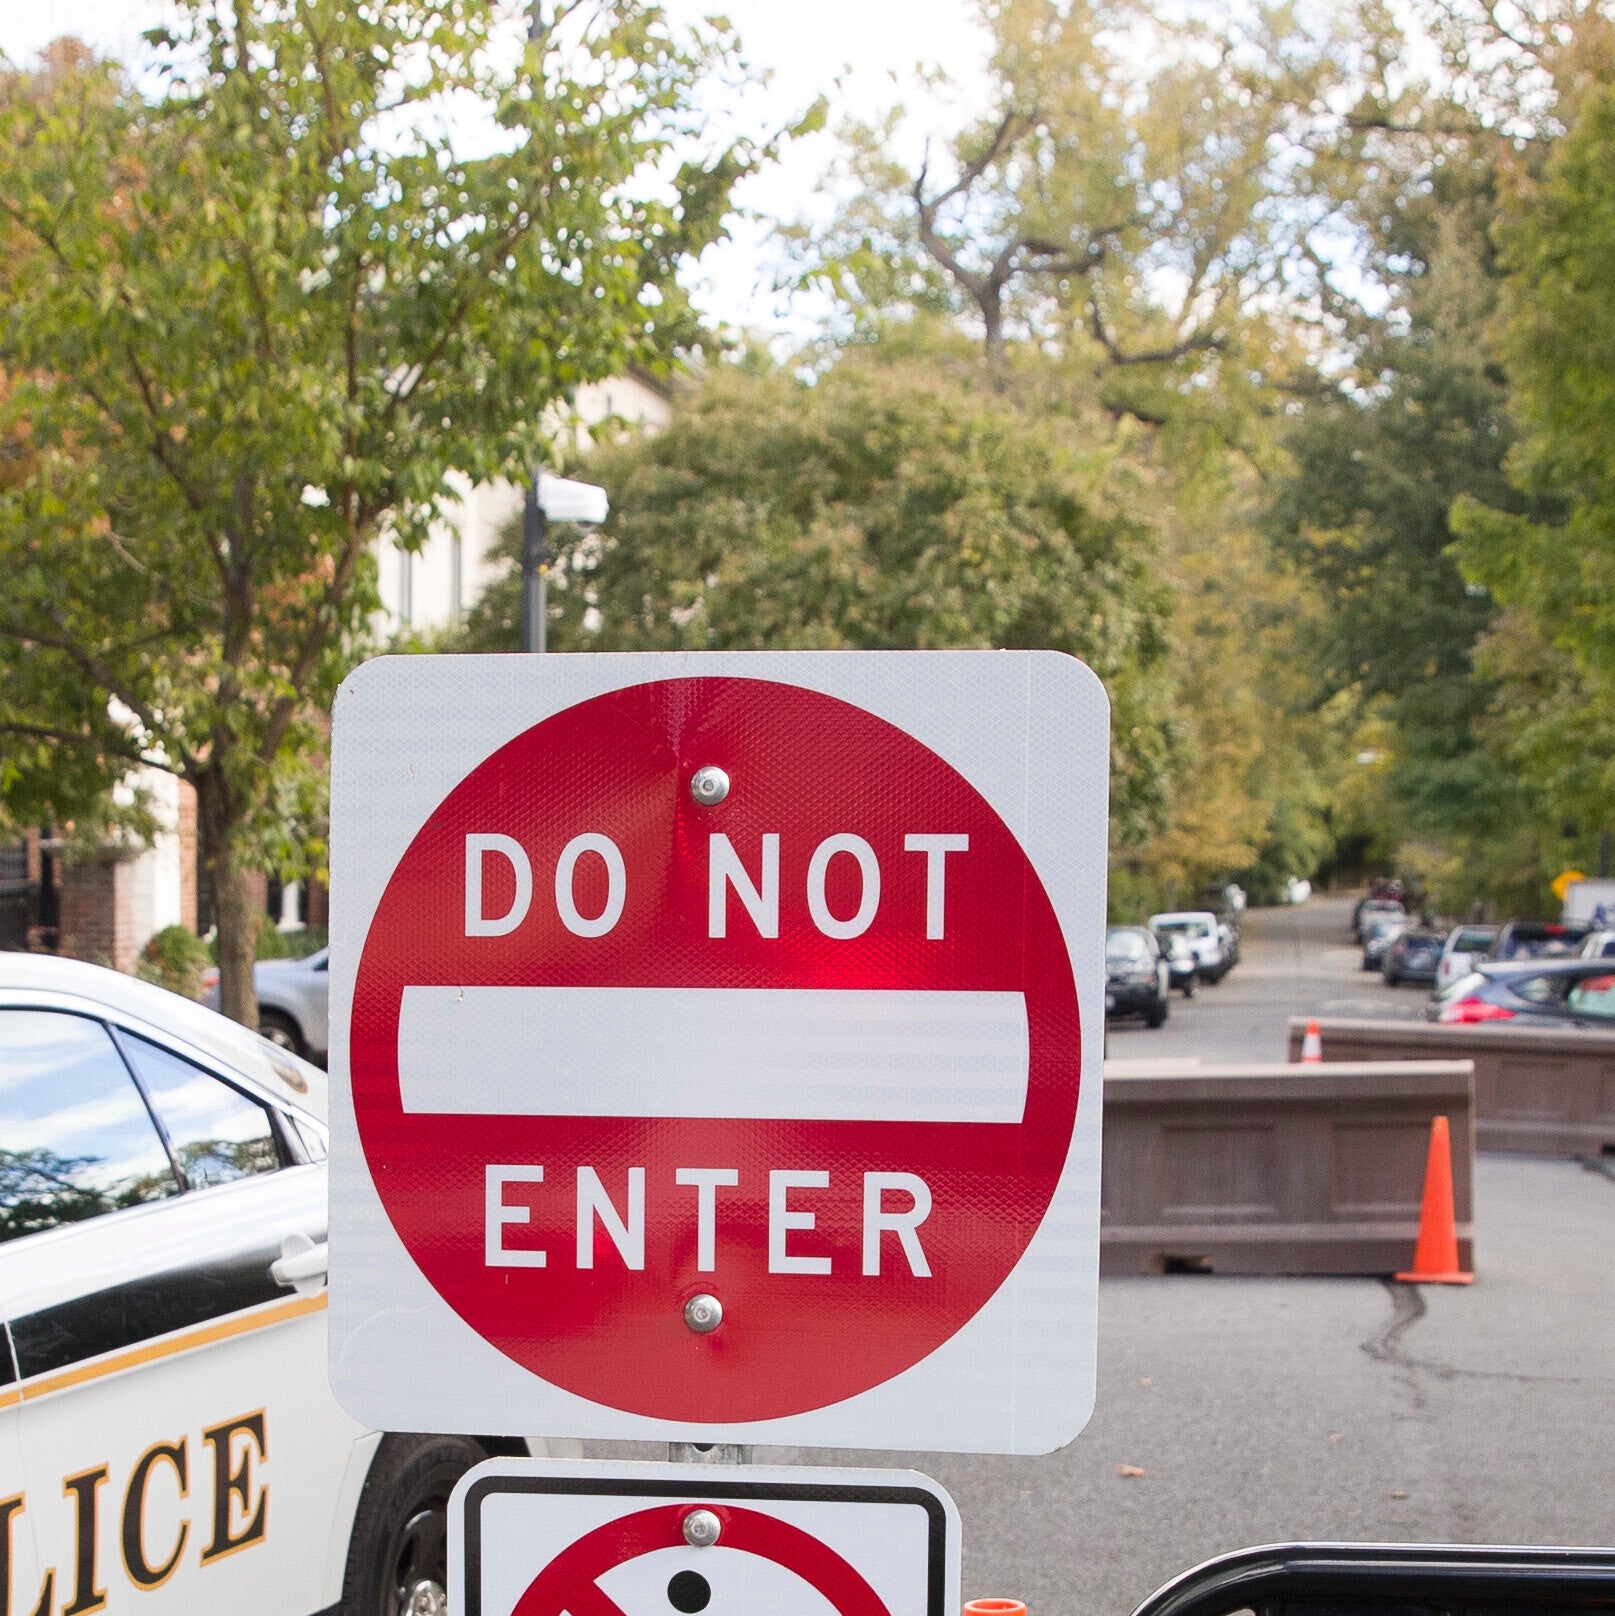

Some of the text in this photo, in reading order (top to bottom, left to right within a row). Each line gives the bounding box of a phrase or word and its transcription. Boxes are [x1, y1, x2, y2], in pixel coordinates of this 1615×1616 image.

[464, 831, 970, 942] DO NOT
[484, 1164, 934, 1279] ENTER
